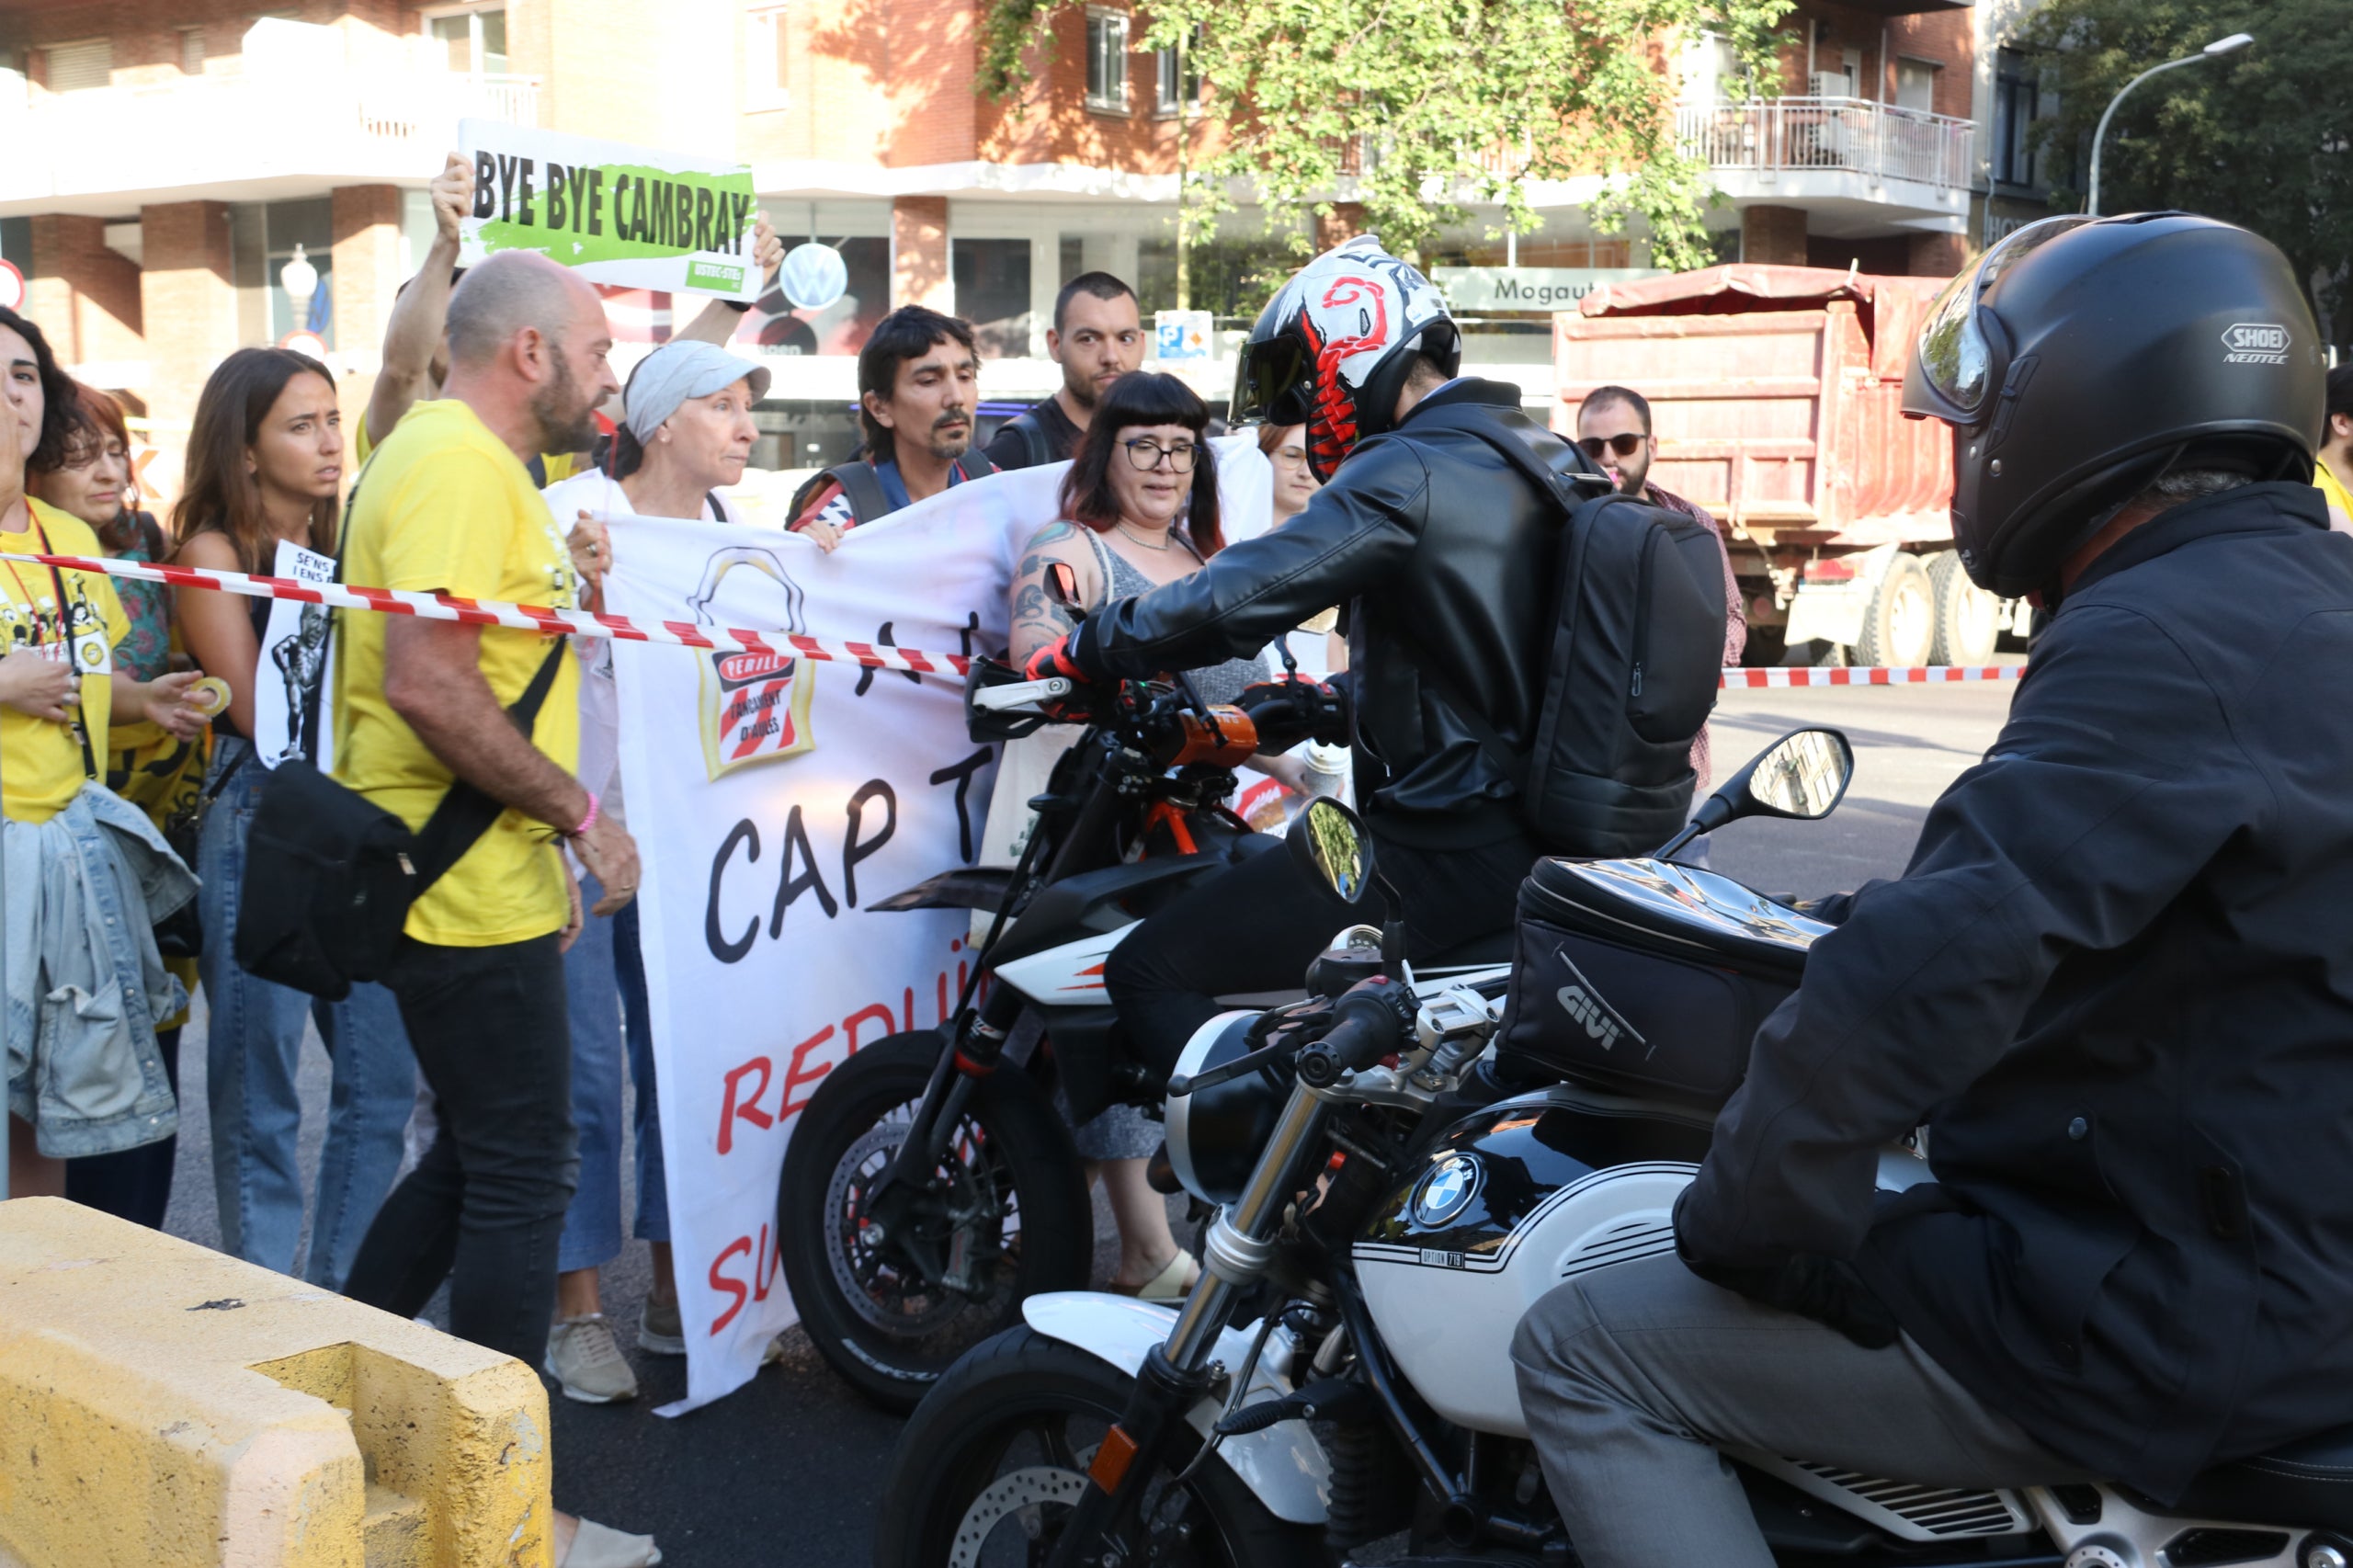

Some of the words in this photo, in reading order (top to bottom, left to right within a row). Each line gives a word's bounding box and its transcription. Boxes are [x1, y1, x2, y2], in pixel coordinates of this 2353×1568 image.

[473, 150, 535, 226] BYE
[546, 163, 603, 236] BYE
[614, 173, 751, 256] CAMBRAY
[2234, 328, 2283, 348] SHOEI
[2222, 353, 2290, 365] NEOTEC
[300, 568, 324, 583] ENS
[726, 653, 780, 677] PERILL
[730, 689, 781, 720] TANCAMENT
[740, 716, 780, 742] D'AULES
[705, 778, 897, 964] CAP
[1557, 985, 1620, 1051] GIVI
[1423, 1250, 1446, 1265] OPTION
[1448, 1252, 1462, 1267] 719
